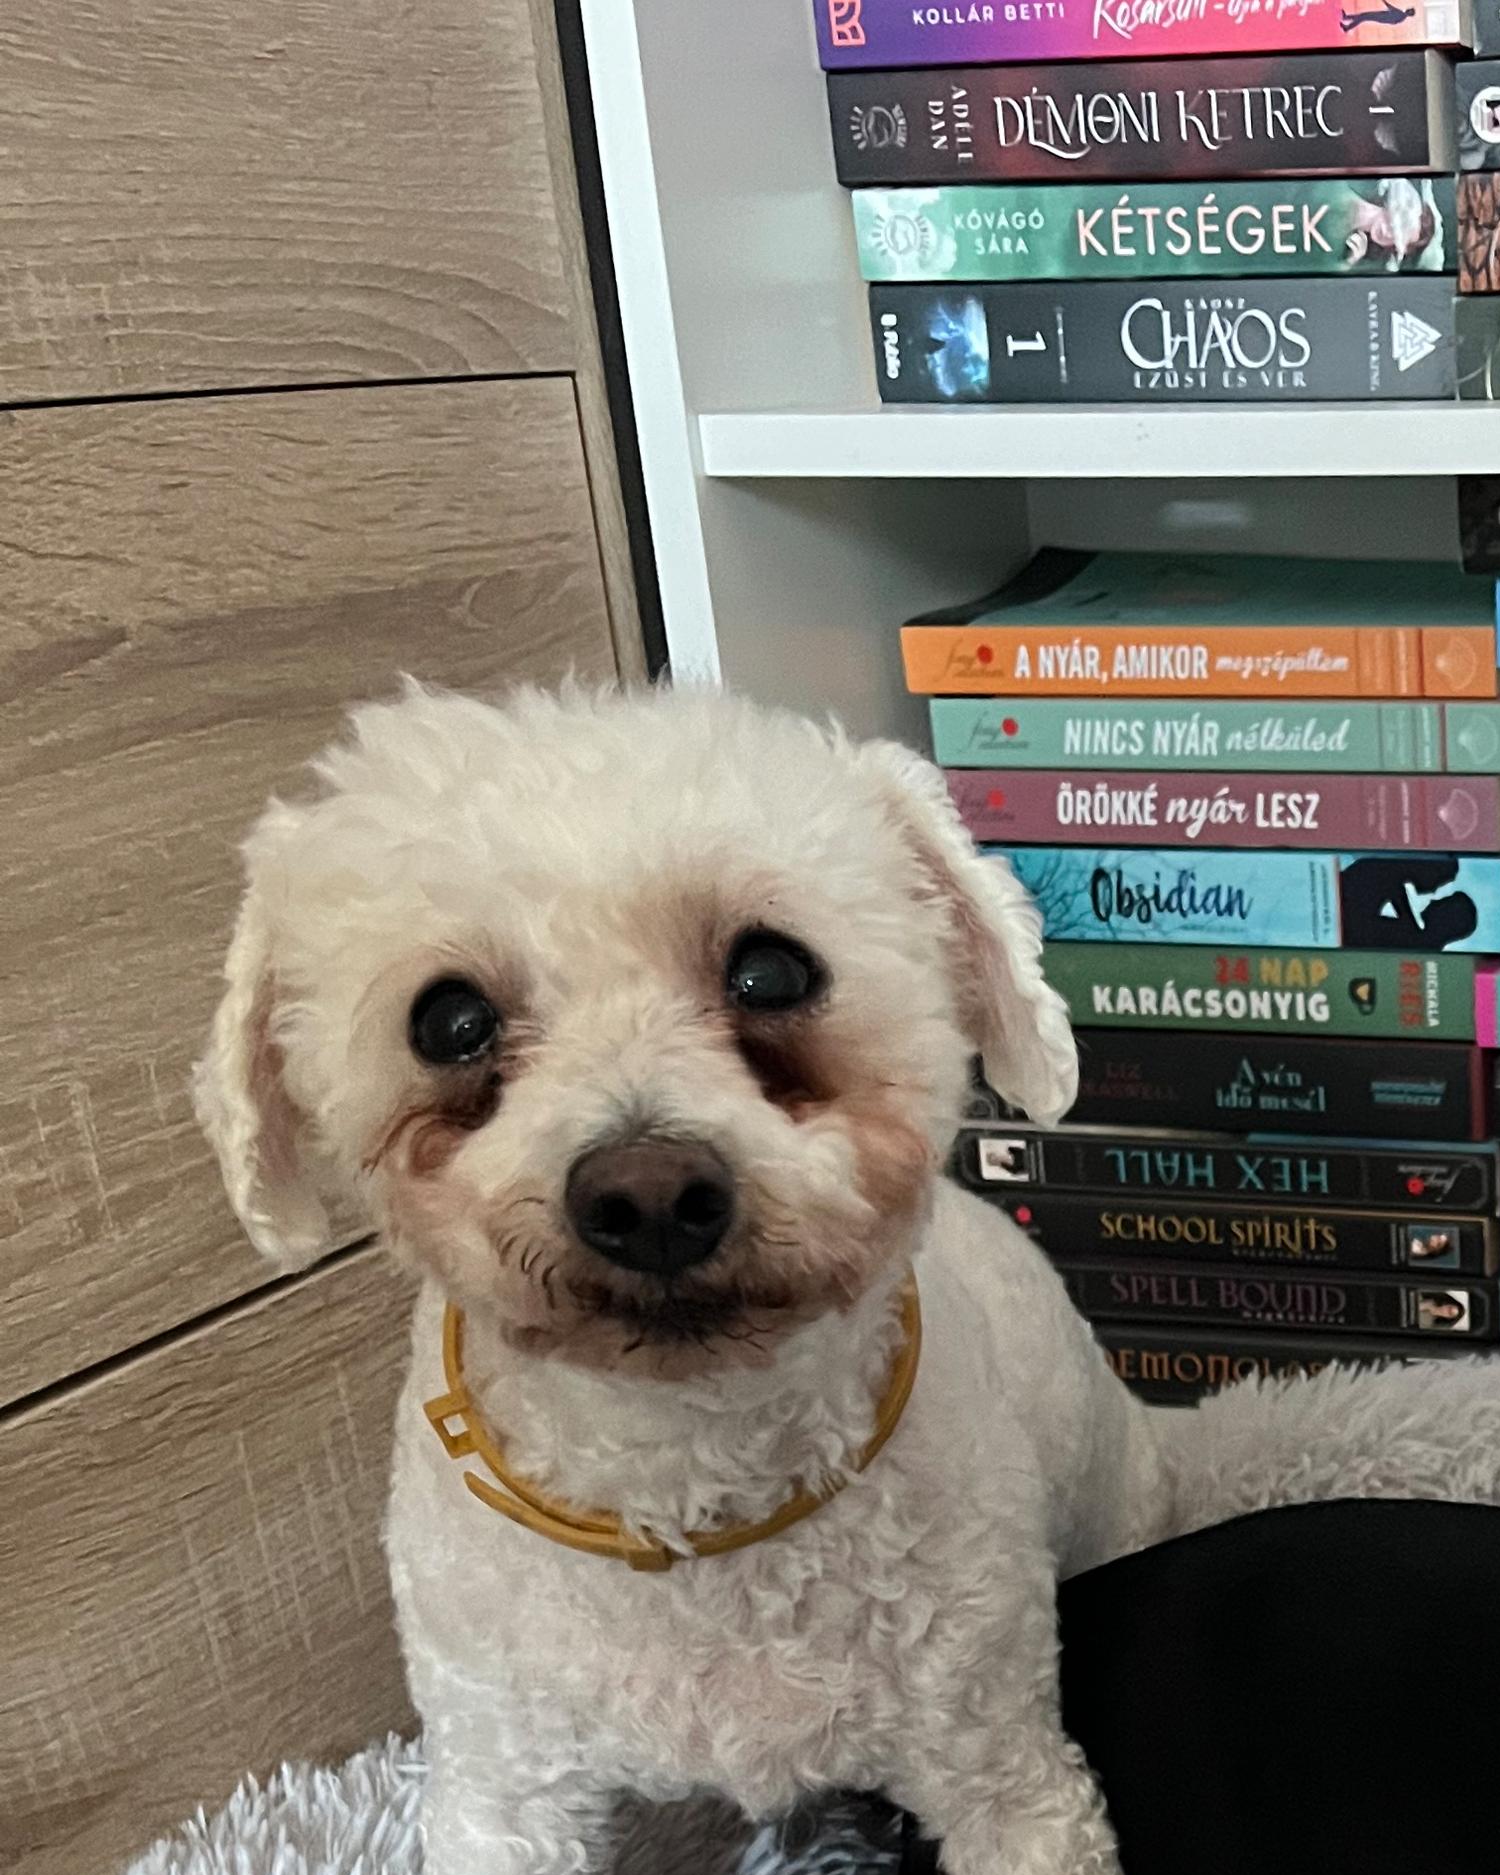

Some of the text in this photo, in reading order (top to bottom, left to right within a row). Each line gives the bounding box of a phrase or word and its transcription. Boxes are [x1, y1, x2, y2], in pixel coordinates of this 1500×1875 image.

[912, 2, 1065, 25] KOLLÁR BETTI
[928, 100, 948, 150] DAN
[993, 85, 1344, 159] DÉMONI KETREC
[975, 234, 1030, 255] SÁRA
[1076, 193, 1333, 257] KÉTSÉGEK
[1006, 331, 1047, 357] 1
[1120, 297, 1312, 370] CHAOS
[1014, 644, 1031, 679] A
[1038, 637, 1108, 684] NYÁR,
[1112, 644, 1209, 680] AMIKOR
[1063, 718, 1145, 755] NINCS
[1152, 712, 1220, 757] NYÁR
[1225, 717, 1351, 752] nélküled
[1056, 781, 1158, 826] ÖRÖKKÉ
[1164, 785, 1250, 839] nyár
[1255, 791, 1321, 829] LESZ
[1090, 866, 1254, 924] Obsidian
[1259, 956, 1329, 987] NAP
[1091, 979, 1330, 1023] KARÁCSONYIG
[1104, 1149, 1329, 1193] HEX HALL
[1100, 1211, 1337, 1254] SCHOOL SPIRITS
[1110, 1273, 1347, 1316] SPELL BOUND
